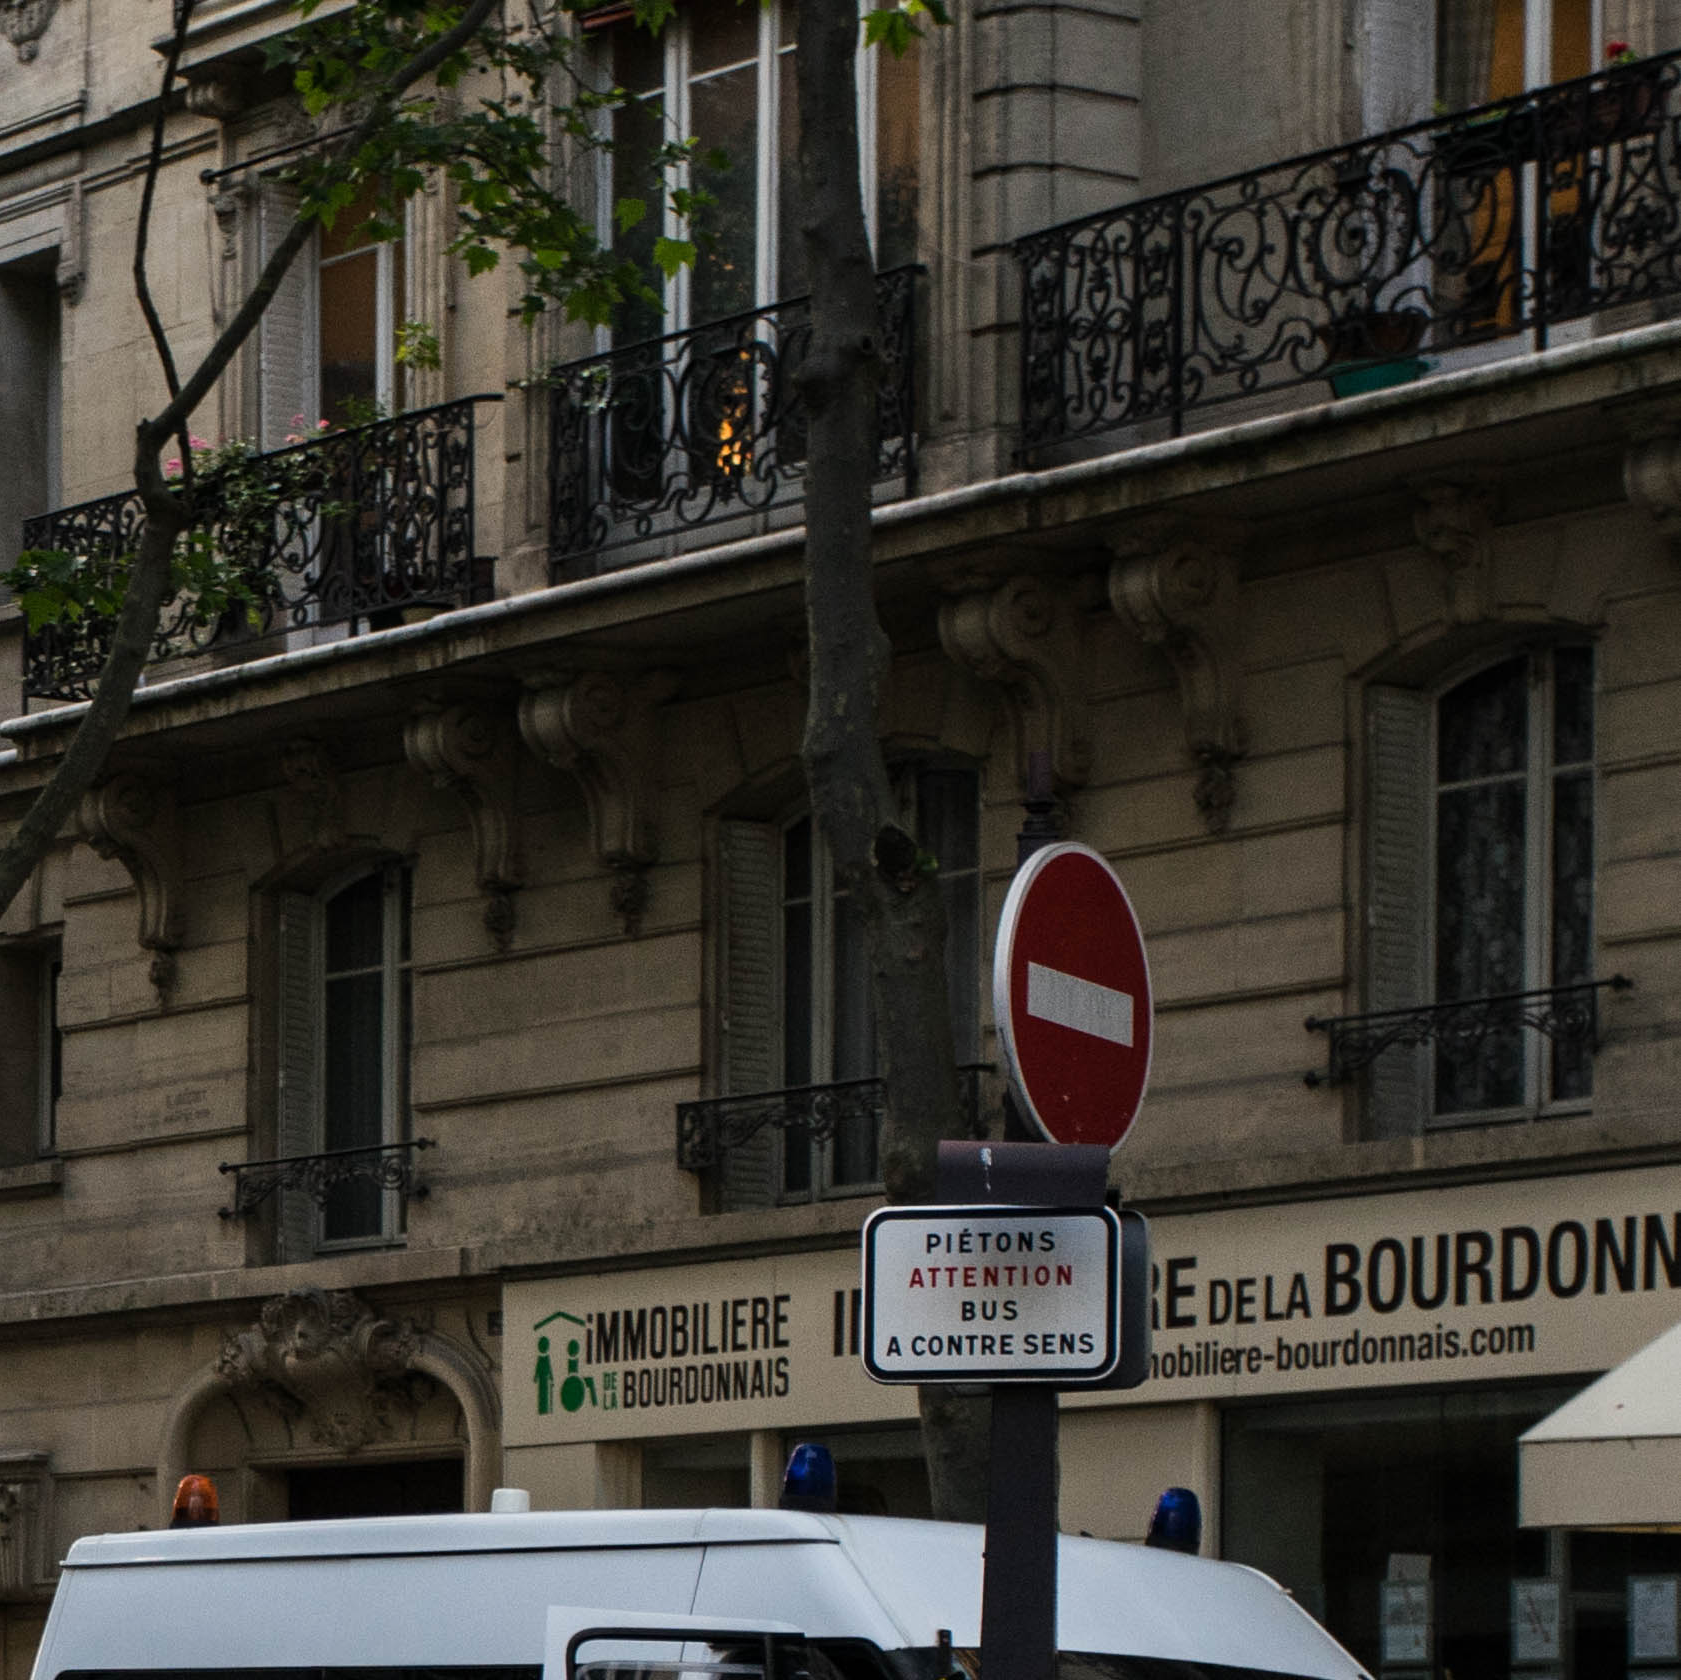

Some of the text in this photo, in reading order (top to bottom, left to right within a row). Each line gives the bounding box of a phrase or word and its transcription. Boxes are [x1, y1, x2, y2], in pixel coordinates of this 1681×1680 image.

[925, 1228, 1057, 1255] PIÉTONS
[909, 1264, 1073, 1289] ATTENTION
[961, 1300, 1019, 1321] BUS
[1208, 1278, 1257, 1326] DE
[1264, 1272, 1312, 1322] LA
[886, 1333, 1095, 1357] A CONTRE SENS
[603, 1371, 618, 1390] DE
[623, 1356, 790, 1410] BOURDONNAIS
[603, 1391, 619, 1411] LA
